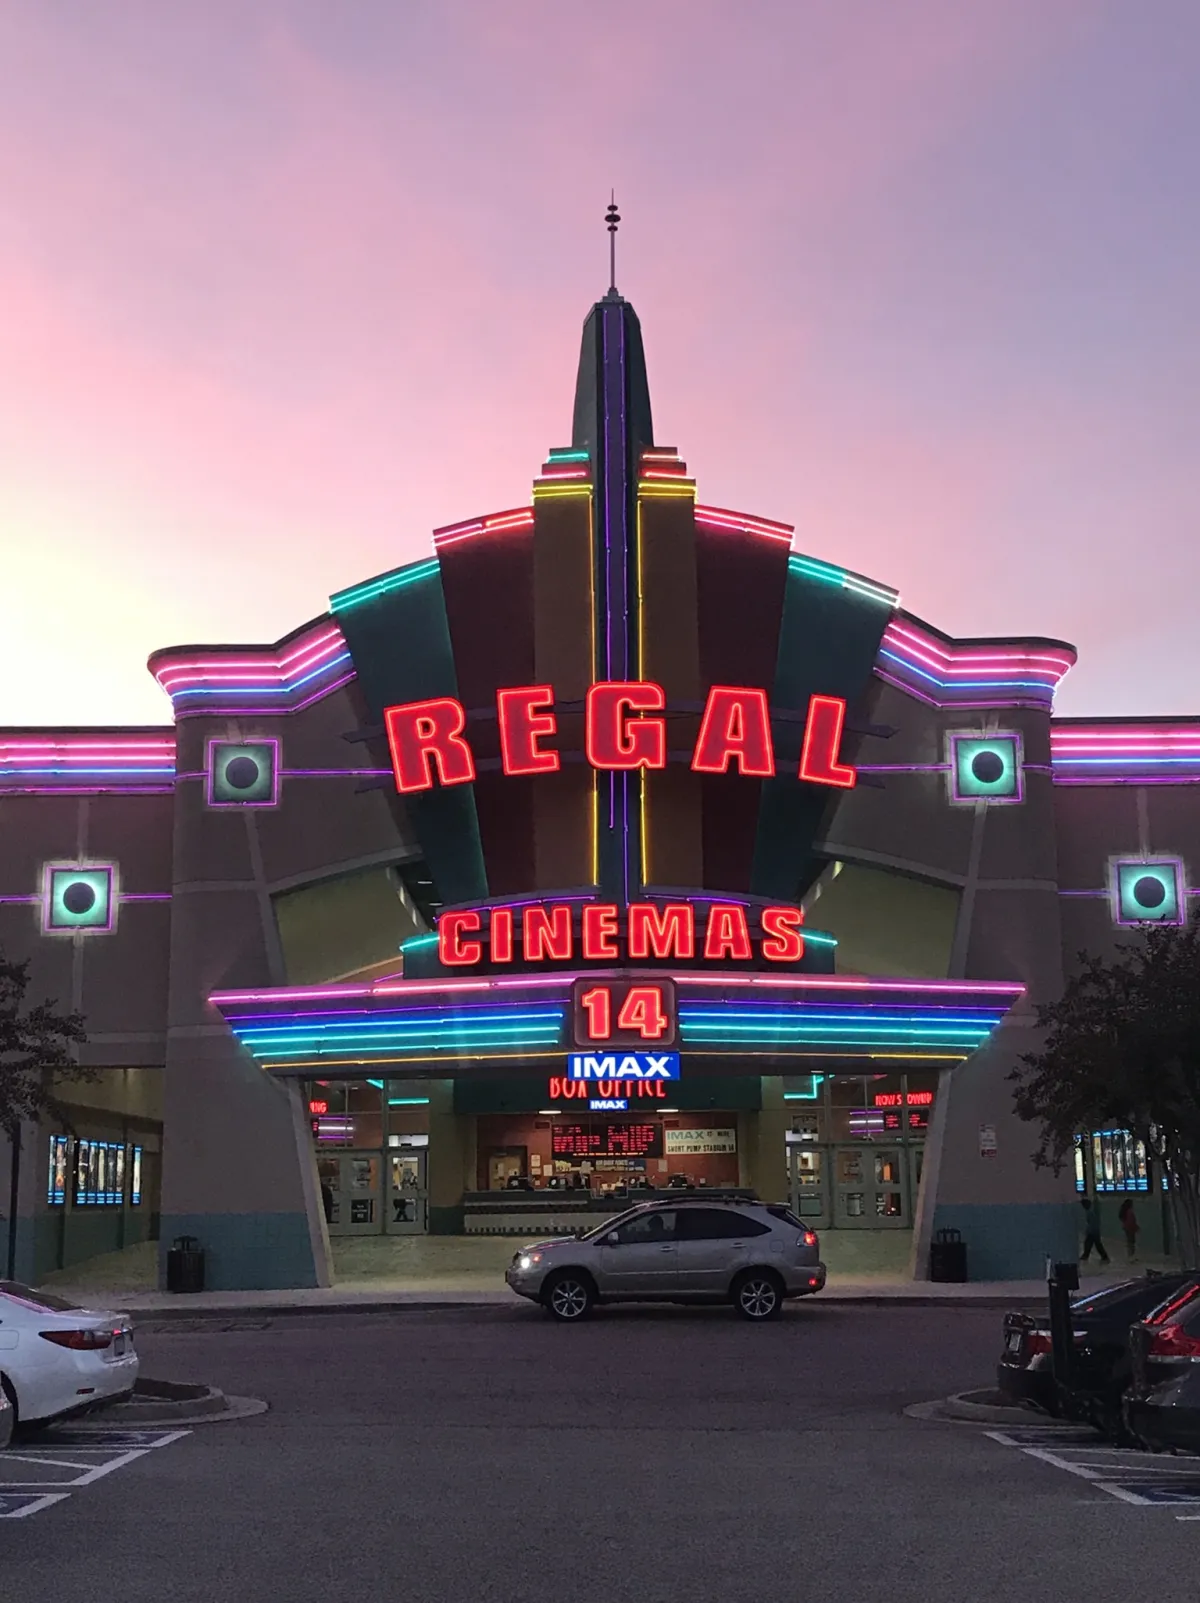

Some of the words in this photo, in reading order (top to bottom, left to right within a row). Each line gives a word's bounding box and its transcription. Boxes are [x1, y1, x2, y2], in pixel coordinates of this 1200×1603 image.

[384, 681, 857, 794] REGAL
[438, 903, 804, 966] CINEMAS
[581, 986, 667, 1040] 14
[573, 1056, 672, 1077] IMAX
[549, 1077, 588, 1099] BOX
[598, 1079, 666, 1098] OFFICE
[590, 1100, 625, 1110] IMAX
[667, 1131, 704, 1140] IMAX
[686, 1145, 702, 1153] PUMP
